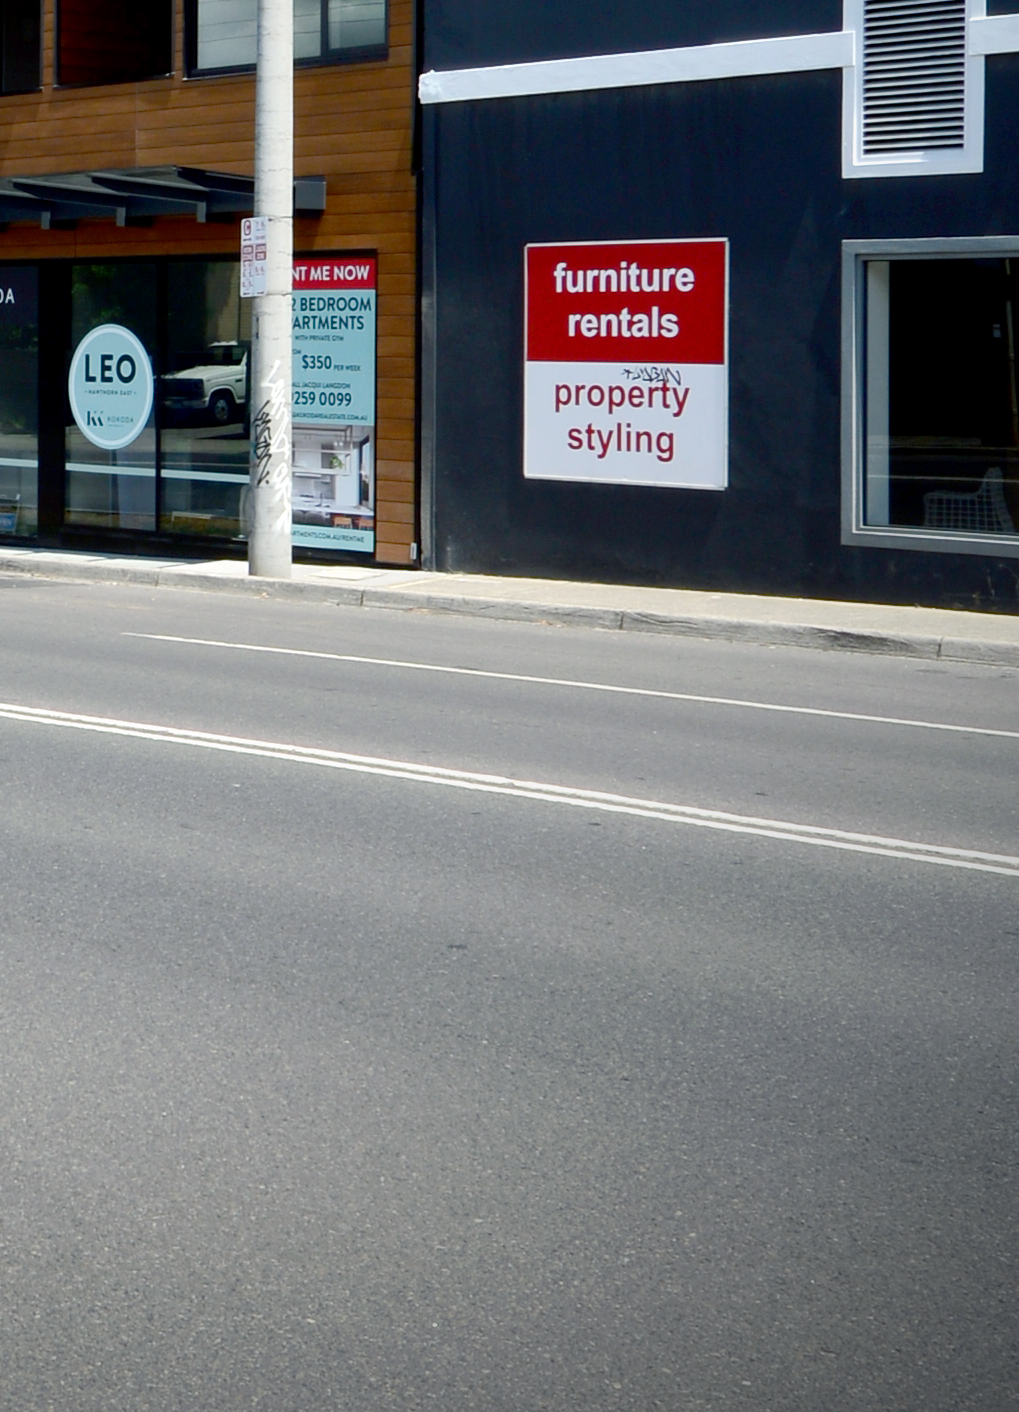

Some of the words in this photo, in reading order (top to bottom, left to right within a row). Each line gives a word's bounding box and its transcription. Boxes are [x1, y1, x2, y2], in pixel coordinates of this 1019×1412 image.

[292, 266, 308, 281] NT
[309, 266, 330, 281] ME
[333, 265, 370, 281] NOW
[553, 261, 696, 293] furniture
[300, 297, 372, 311] BEDROOM
[292, 315, 364, 330] ARTMENTS
[568, 306, 680, 338] rentals
[85, 353, 137, 384] LEO
[302, 354, 332, 370] $350
[292, 391, 316, 406] 259
[318, 392, 352, 407] 0099
[555, 381, 691, 417] property
[567, 423, 675, 463] styling
